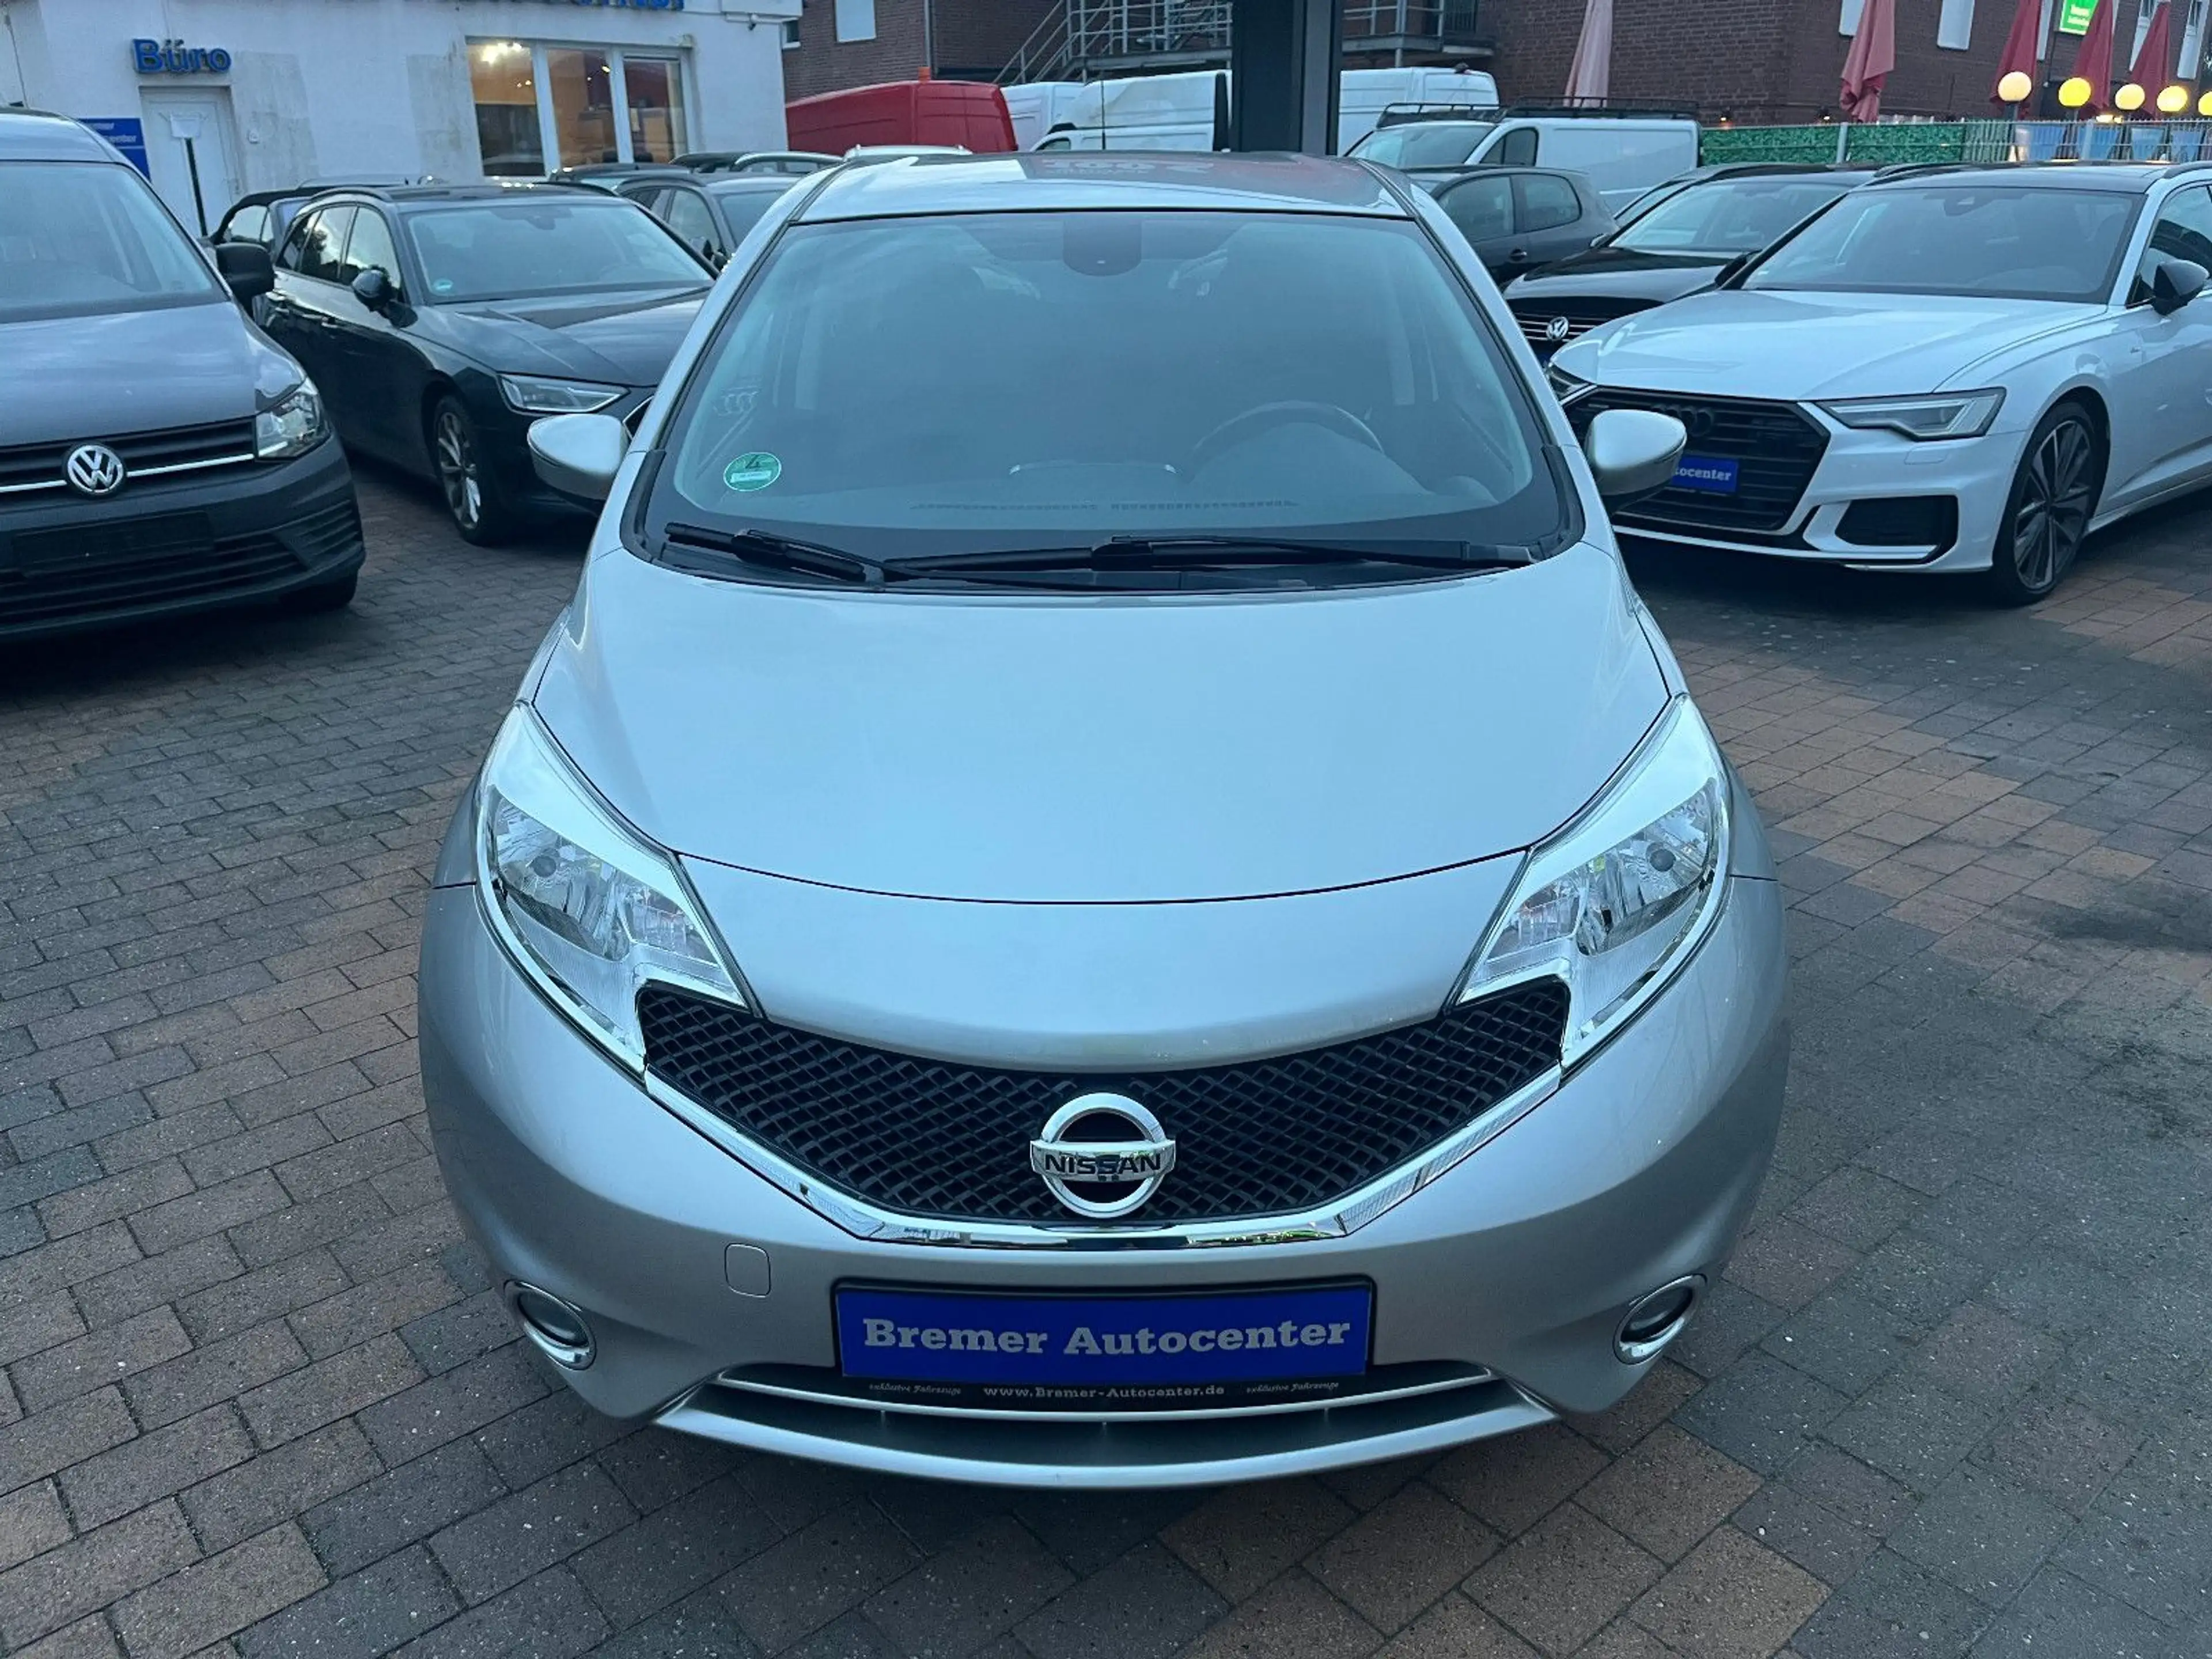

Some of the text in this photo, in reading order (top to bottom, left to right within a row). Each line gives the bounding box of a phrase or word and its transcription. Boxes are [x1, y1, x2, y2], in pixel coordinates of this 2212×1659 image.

[132, 38, 232, 73] Büro
[1045, 1153, 1161, 1175] NISSAN
[863, 1318, 1350, 1355] Bremer Autocenter
[983, 1385, 1225, 1399] www.Bremer-Autocenter.de
